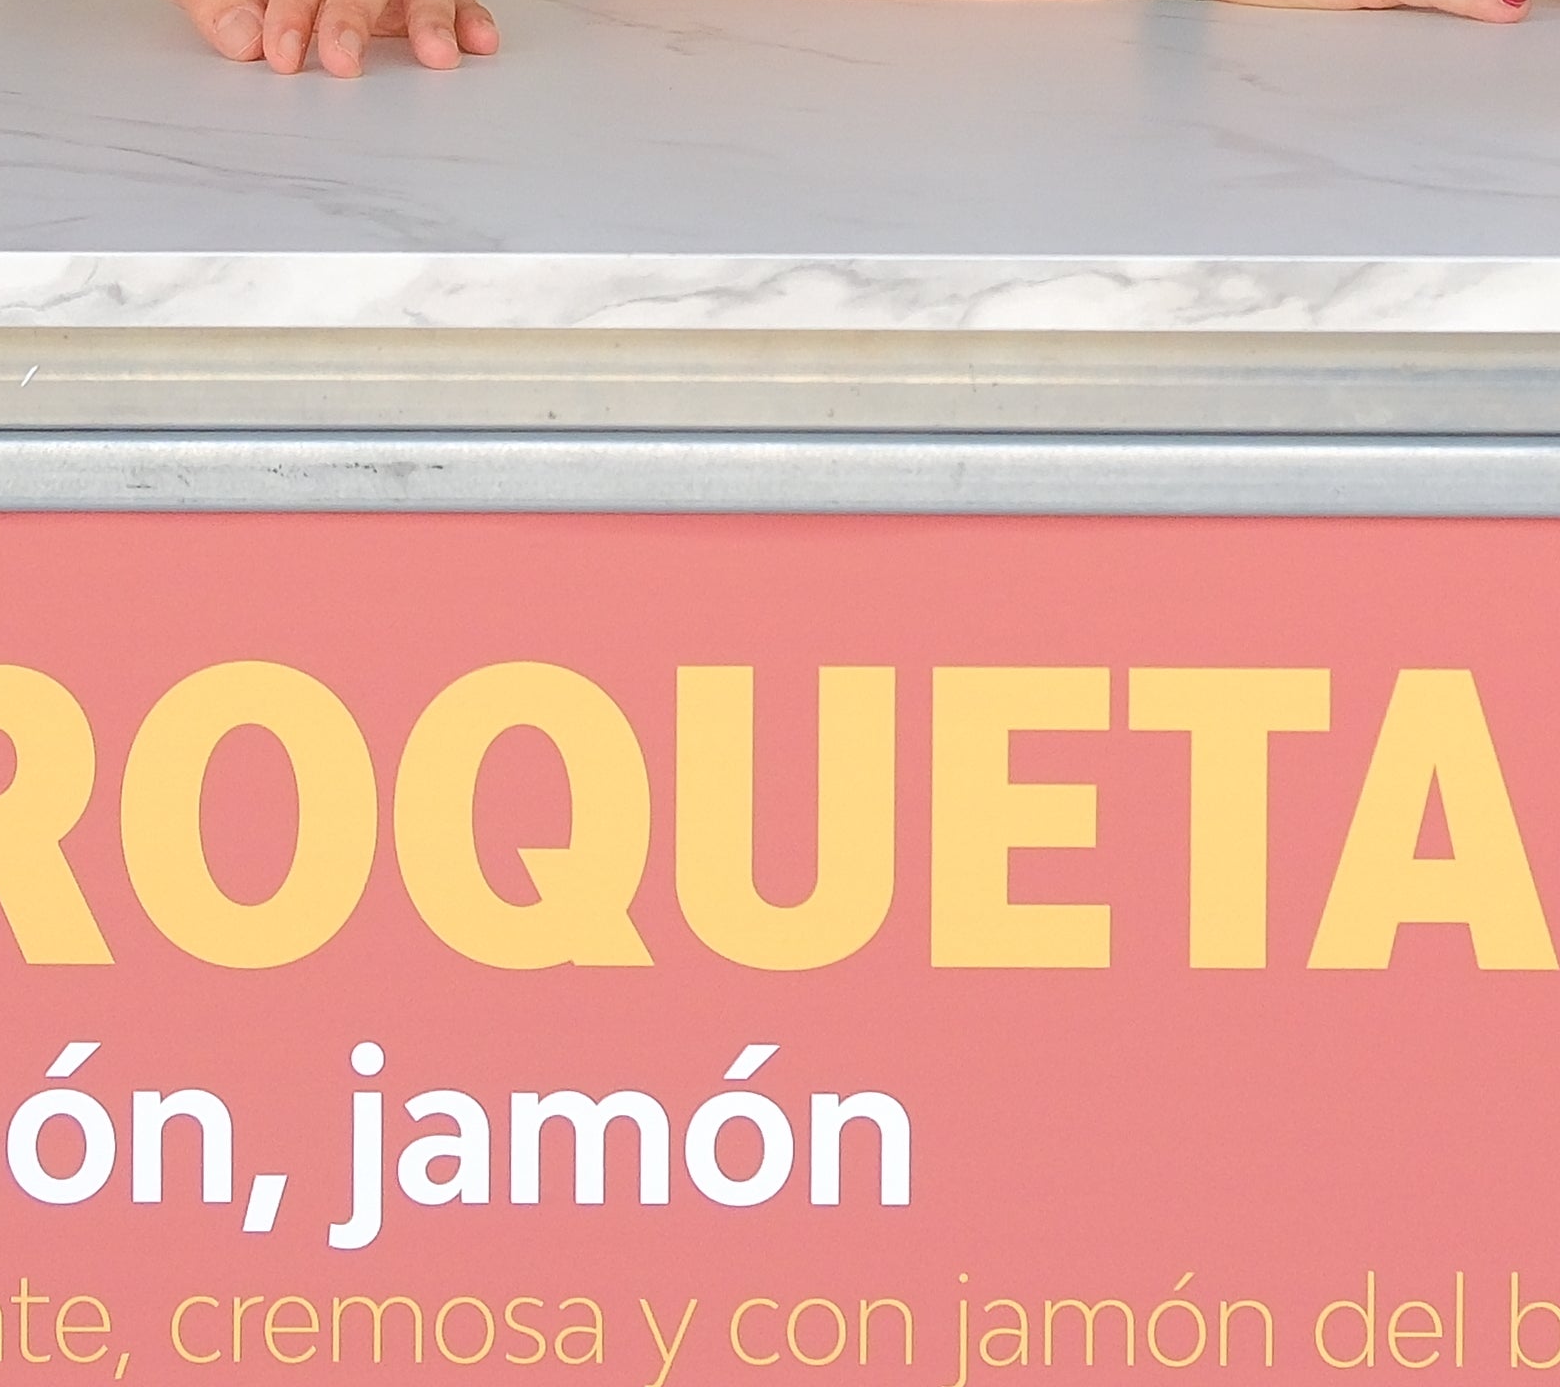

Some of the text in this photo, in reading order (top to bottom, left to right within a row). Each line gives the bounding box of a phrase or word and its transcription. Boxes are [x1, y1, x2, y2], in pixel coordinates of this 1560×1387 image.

[328, 1042, 912, 1249] jamón
[171, 1295, 607, 1365] cremosa
[639, 1297, 698, 1387] y
[729, 1296, 913, 1366] con
[943, 1271, 1273, 1387] jamón
[1314, 1270, 1464, 1369] del
